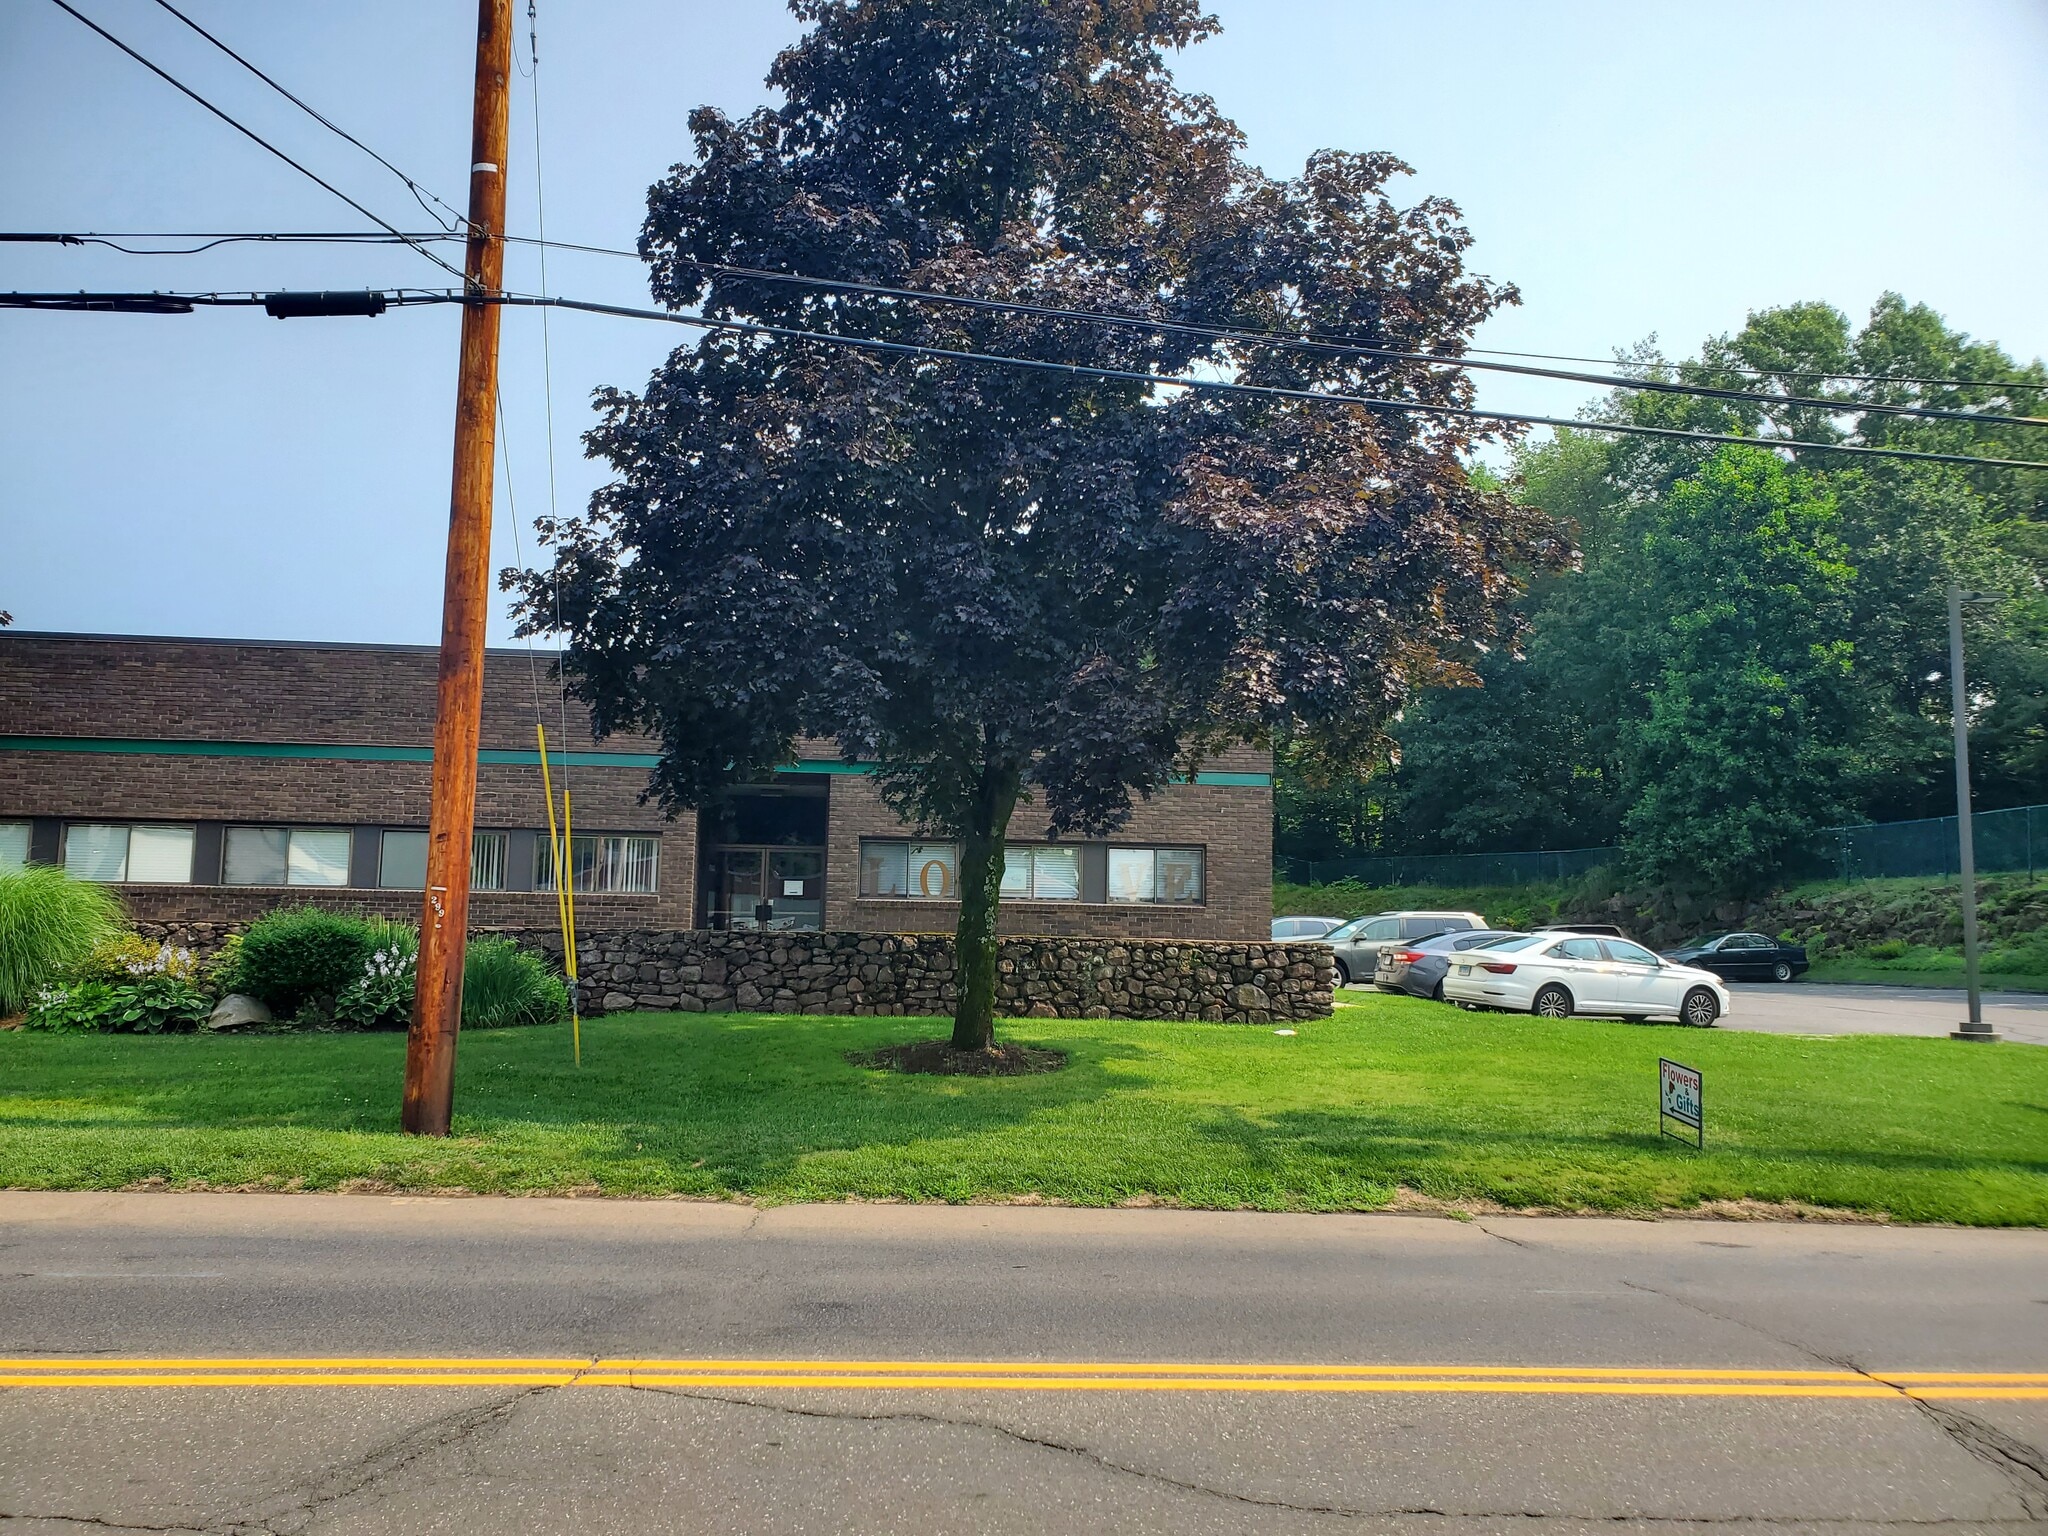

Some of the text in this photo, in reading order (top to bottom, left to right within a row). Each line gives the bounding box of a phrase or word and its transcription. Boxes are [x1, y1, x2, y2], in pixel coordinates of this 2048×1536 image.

[431, 895, 445, 918] 299
[1662, 1062, 1698, 1091] Flowers
[1676, 1094, 1700, 1117] Gifts
